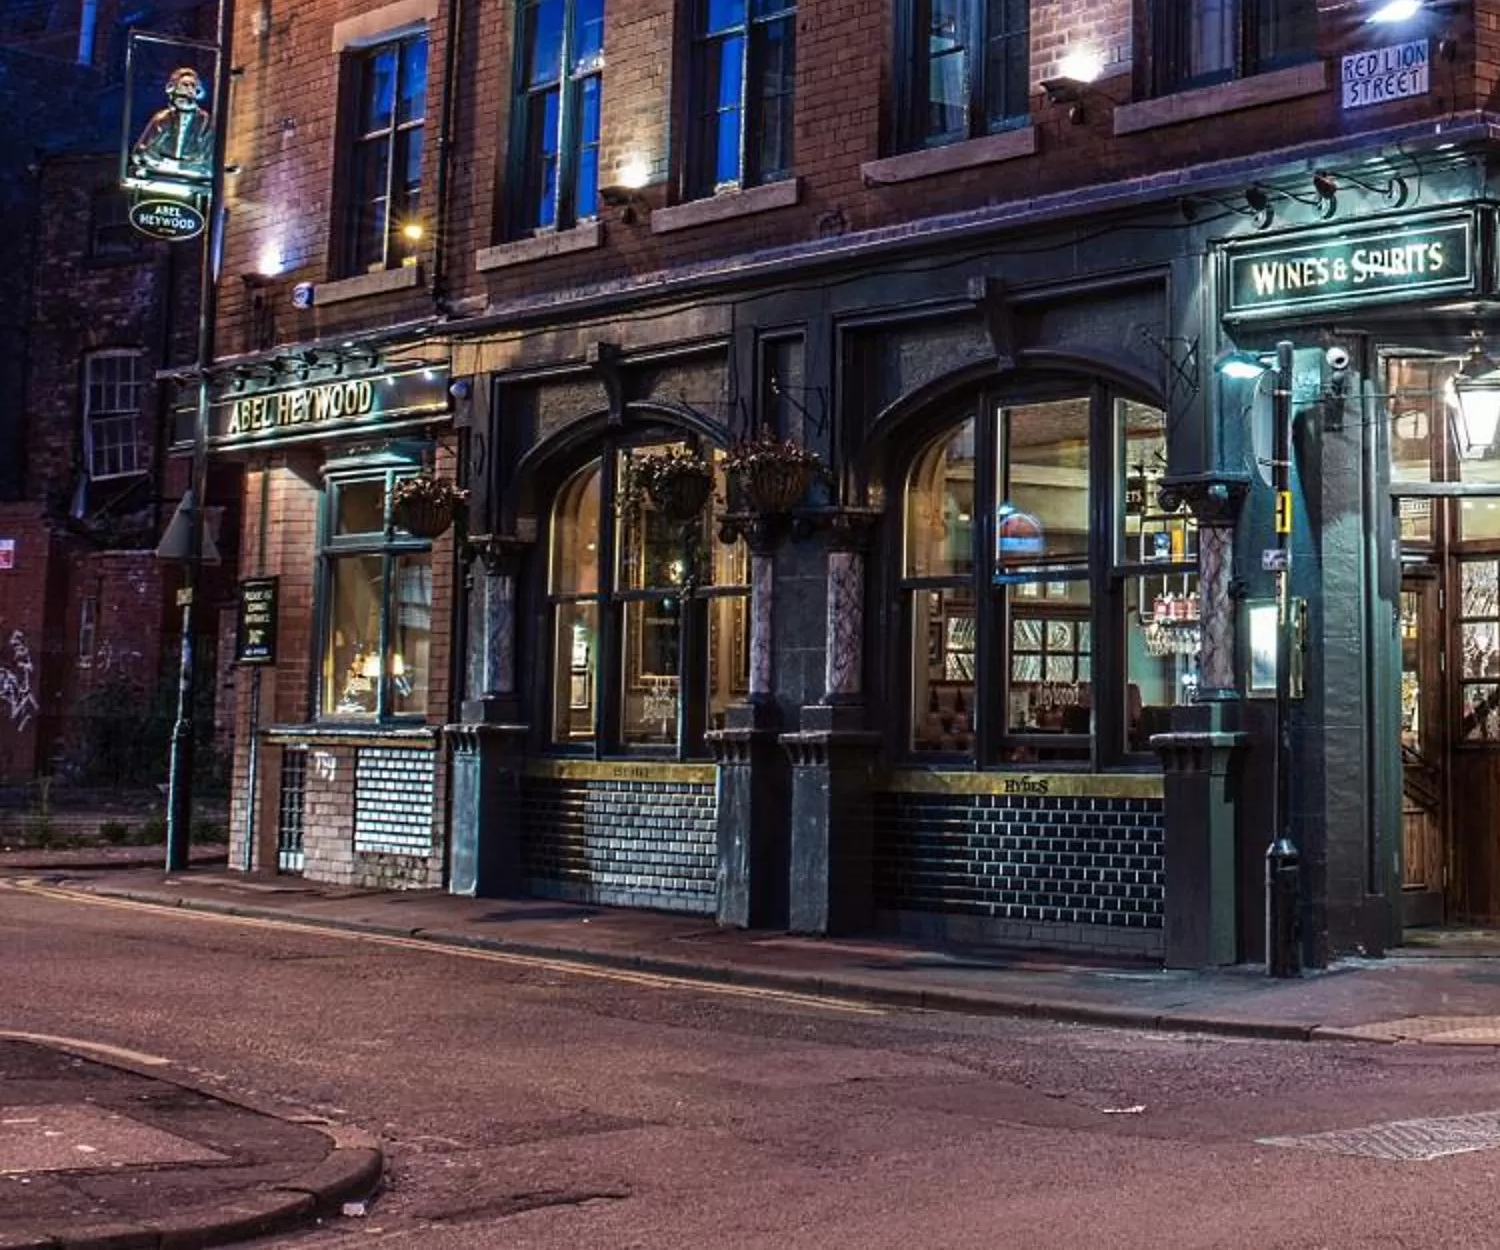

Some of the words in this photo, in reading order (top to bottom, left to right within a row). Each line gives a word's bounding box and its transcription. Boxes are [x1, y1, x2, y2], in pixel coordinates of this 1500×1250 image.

[1344, 54, 1379, 79] RED
[1385, 44, 1426, 71] LION
[1351, 70, 1419, 103] STREET
[139, 213, 195, 230] HEYWOOD
[1251, 257, 1328, 296] WINES
[1331, 258, 1346, 282] &
[1352, 241, 1444, 284] SPIRITS
[228, 396, 272, 434] ABEL
[276, 379, 374, 426] HEYWOOD
